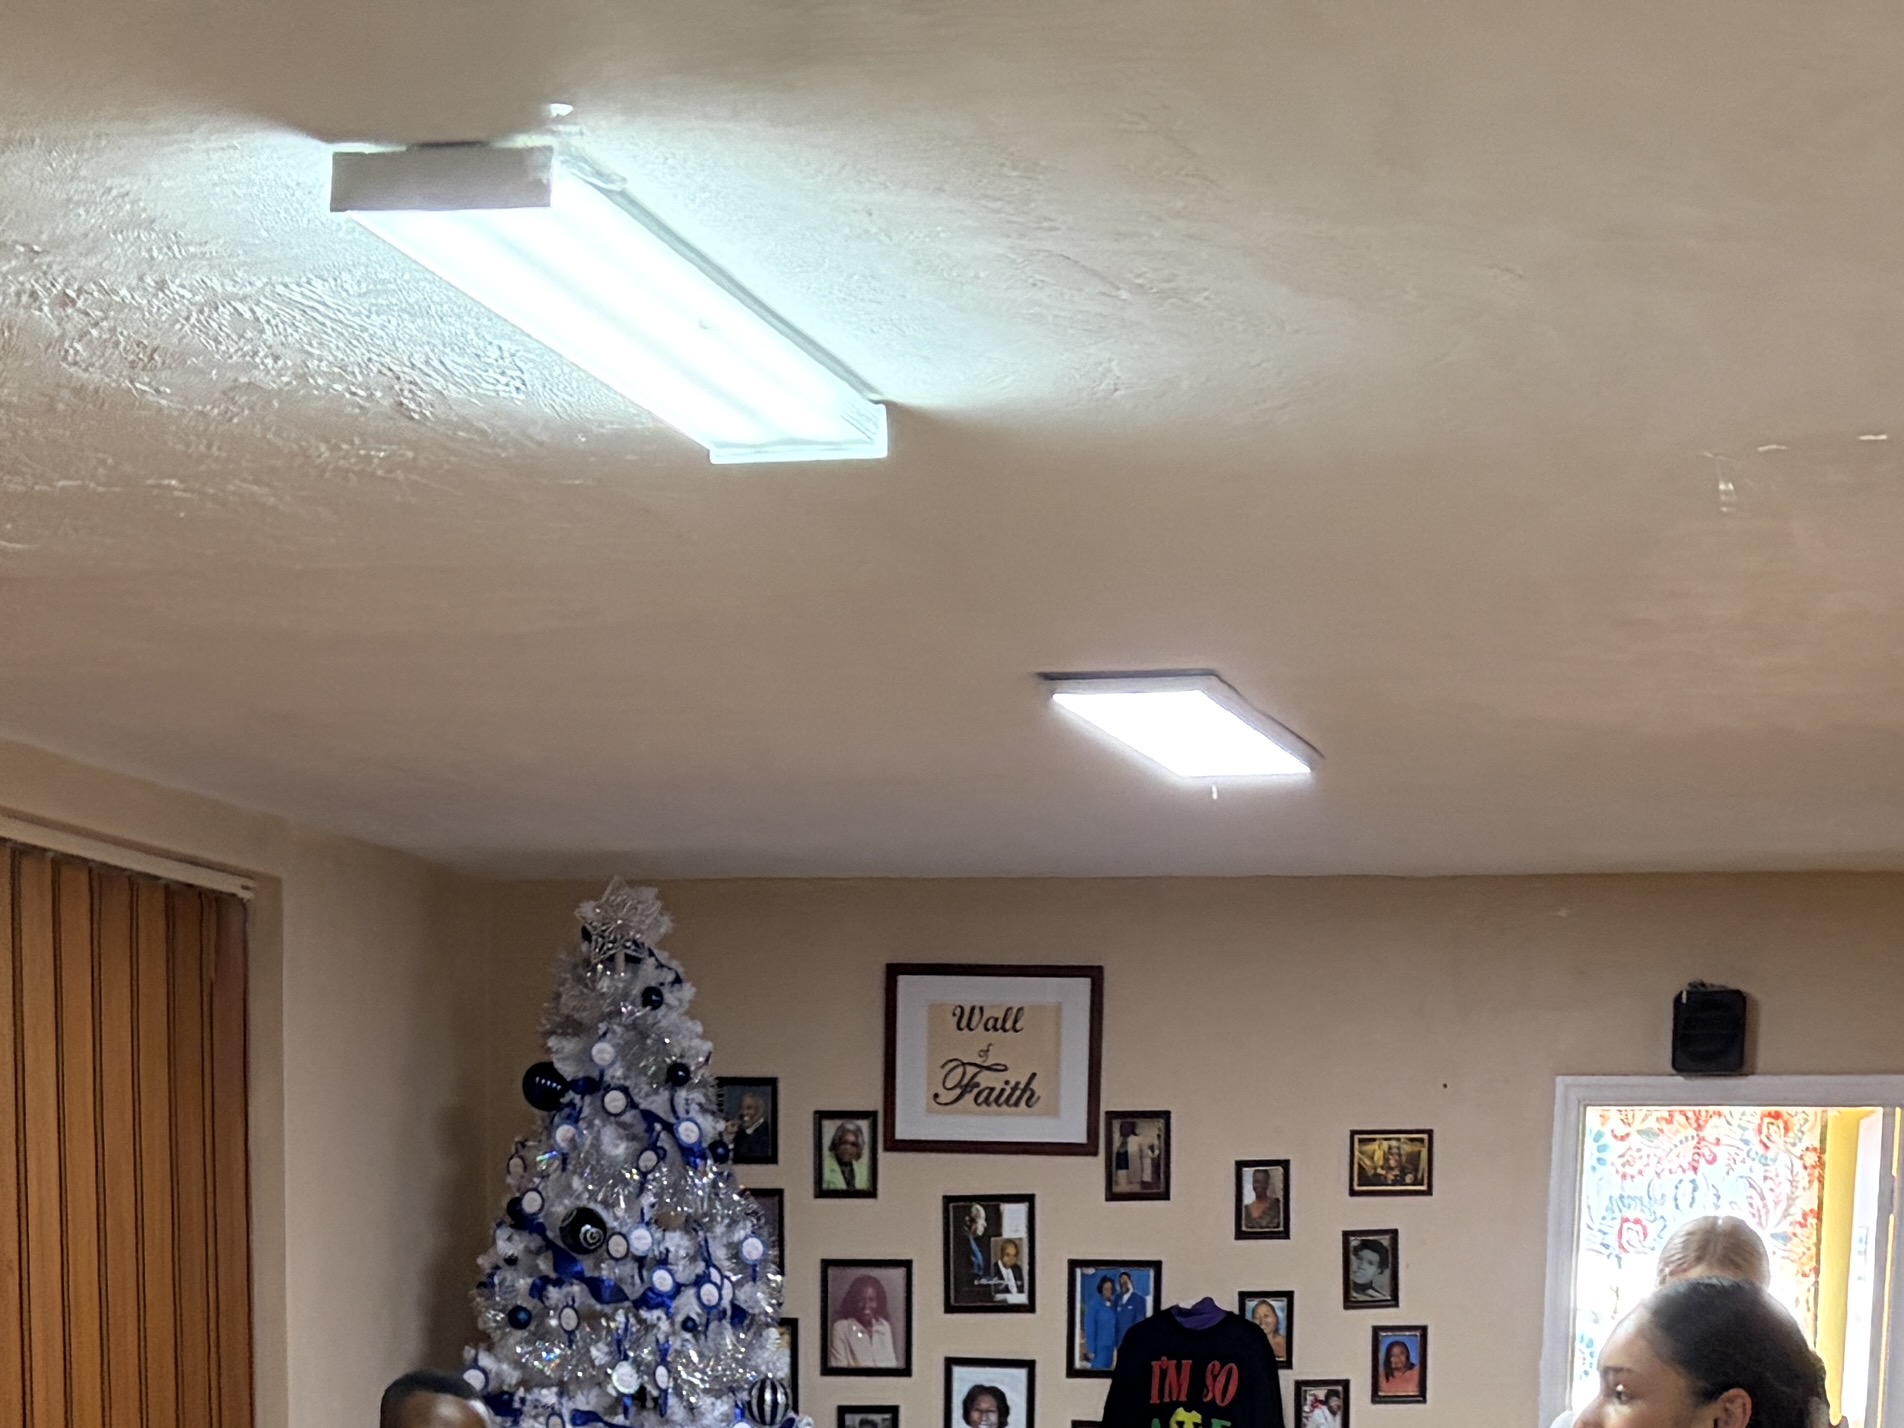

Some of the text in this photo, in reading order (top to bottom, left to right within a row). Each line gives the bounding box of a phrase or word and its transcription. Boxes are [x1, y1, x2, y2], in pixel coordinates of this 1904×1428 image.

[952, 1004, 1025, 1033] Wall
[977, 1042, 994, 1063] of
[933, 1058, 1041, 1109] Faith
[1202, 1360, 1239, 1407] SO
